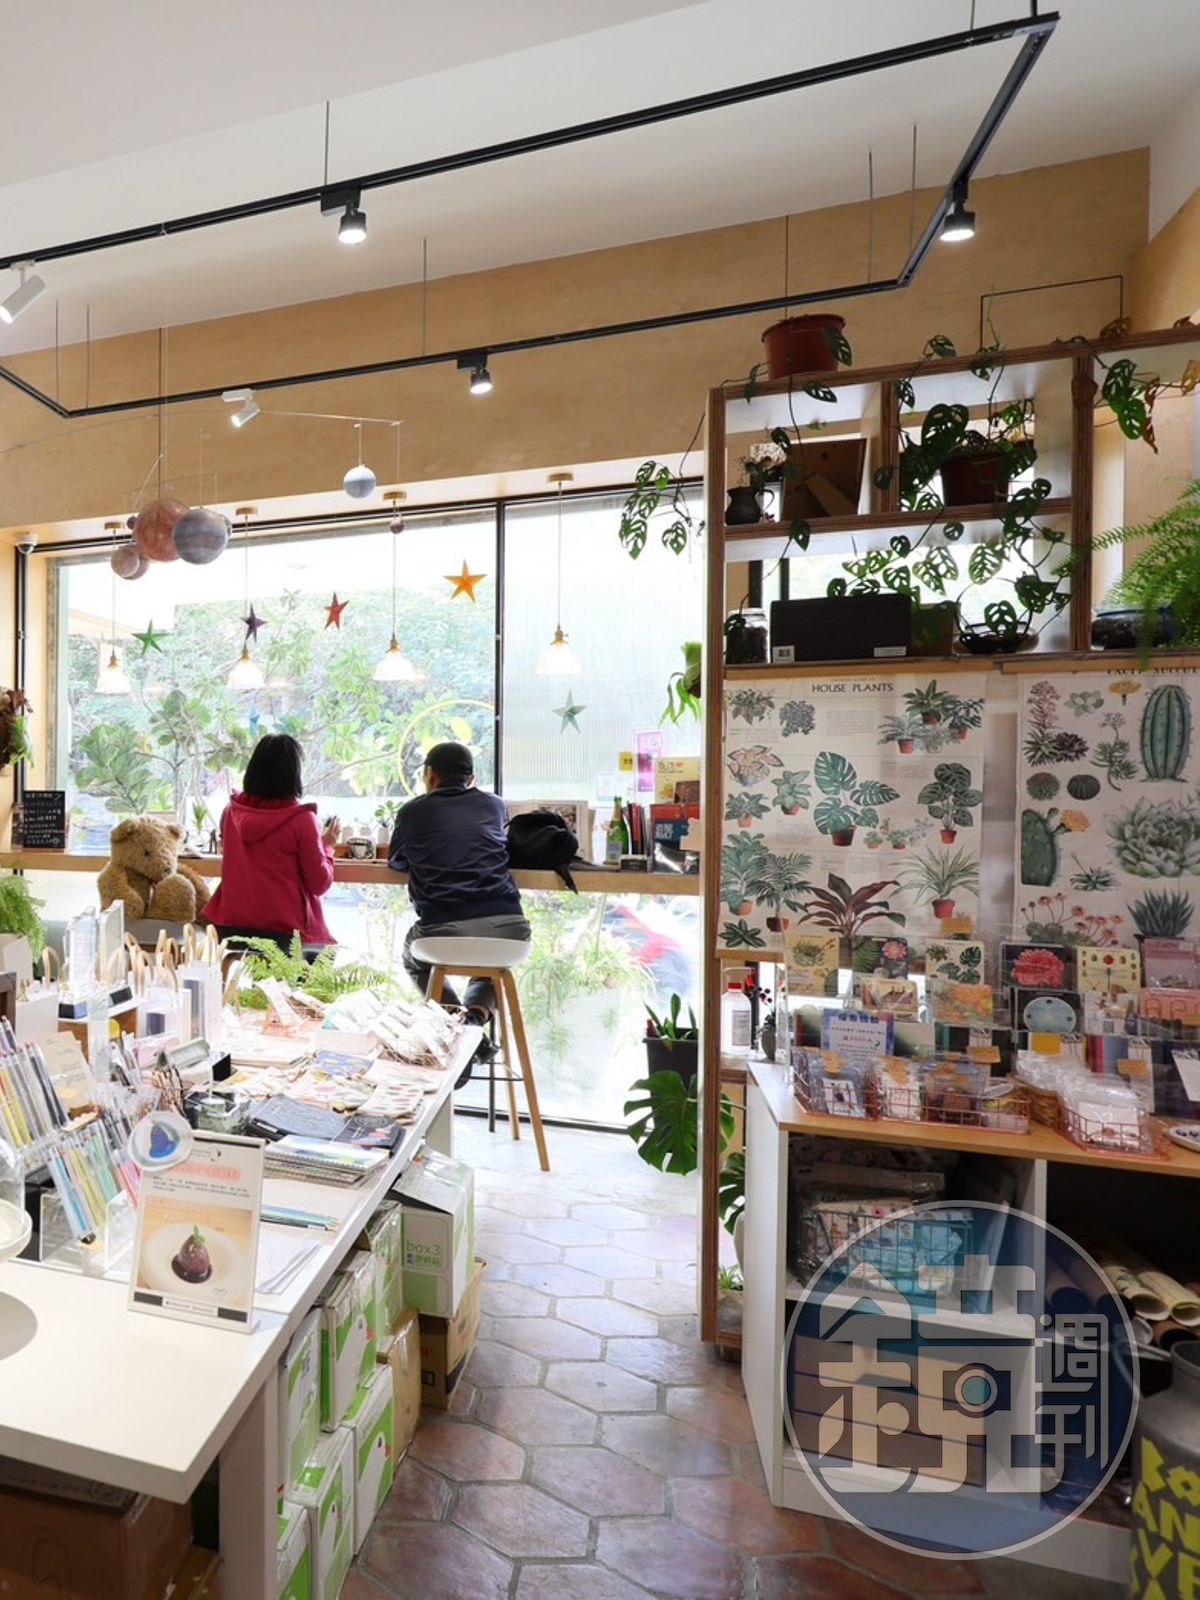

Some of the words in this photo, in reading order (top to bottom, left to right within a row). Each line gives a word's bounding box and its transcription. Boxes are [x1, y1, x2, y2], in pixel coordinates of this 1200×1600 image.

[811, 683, 846, 693] HOUSE
[852, 682, 894, 692] PLANTS
[407, 1240, 441, 1257] box3
